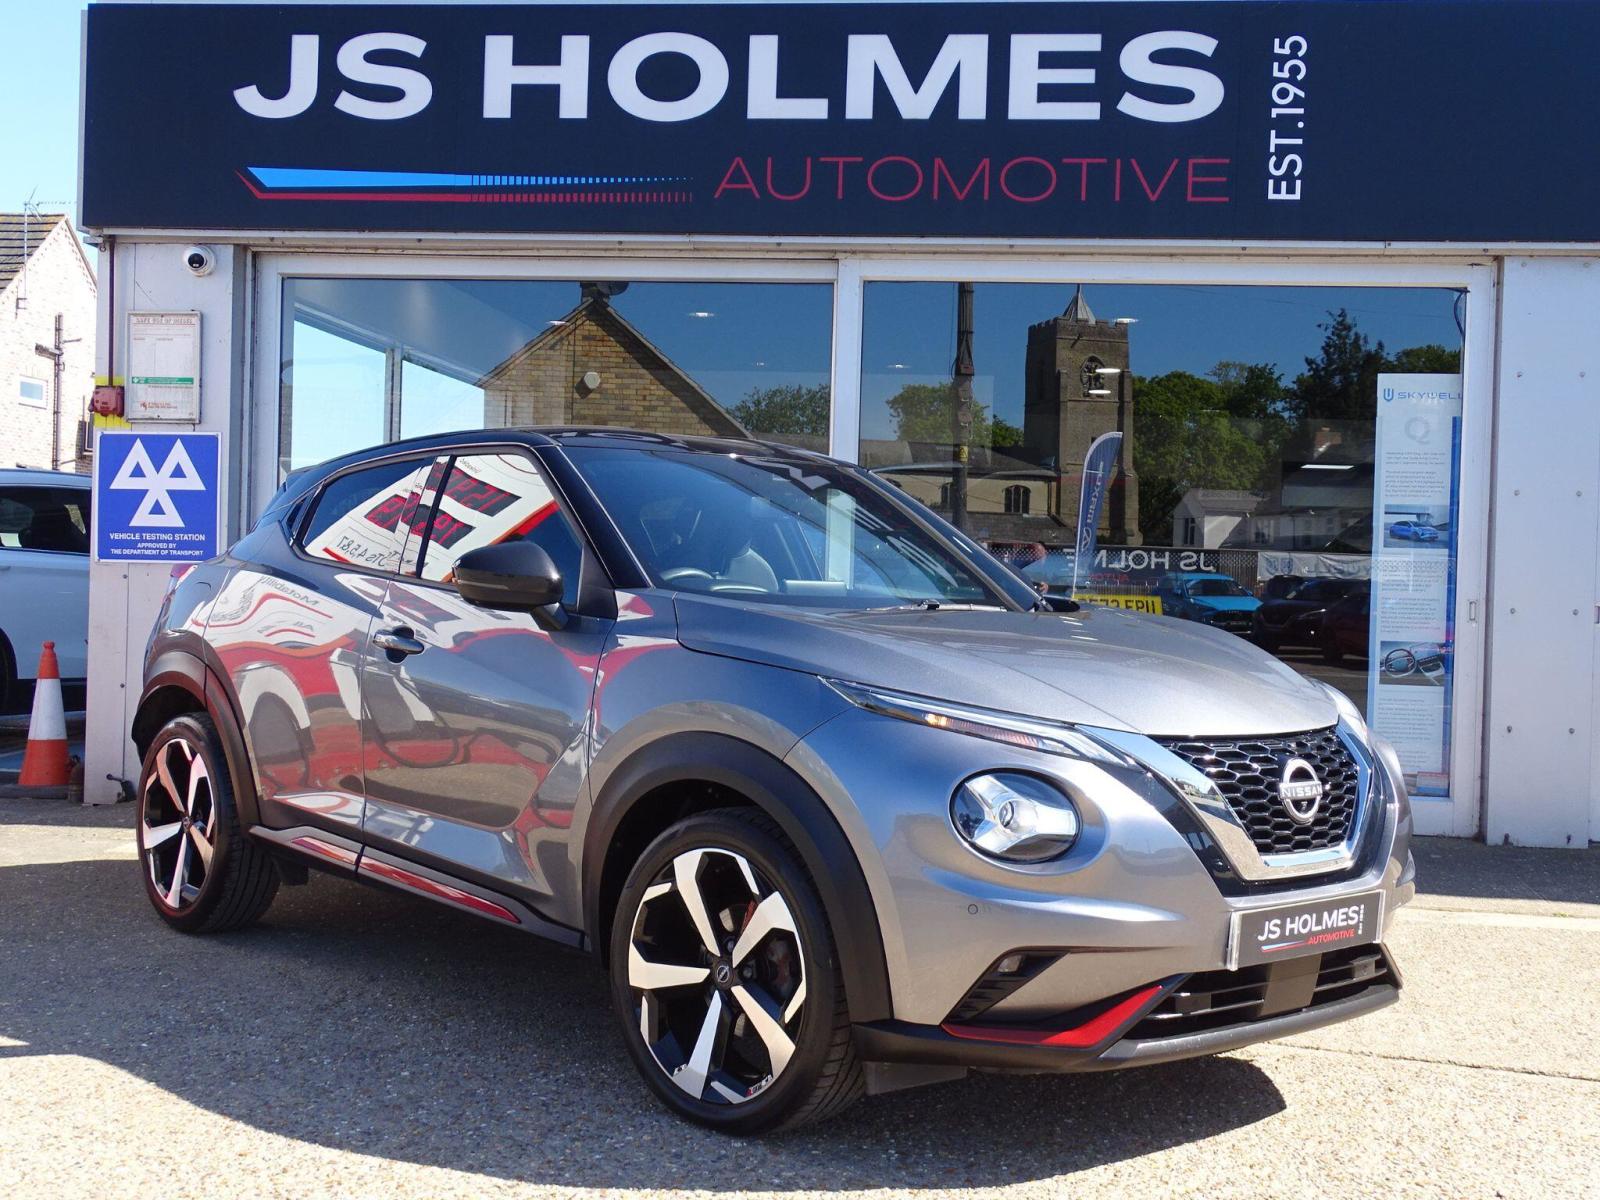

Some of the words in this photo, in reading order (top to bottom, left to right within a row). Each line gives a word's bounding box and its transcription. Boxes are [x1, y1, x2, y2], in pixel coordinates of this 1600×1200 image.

[233, 32, 433, 121] JS
[483, 31, 1226, 123] HOLMES
[1267, 35, 1308, 201] EST.1955
[713, 155, 1231, 204] AUTOMOTIVE
[109, 532, 140, 540] VEHICLE
[142, 533, 173, 541] TESTING
[174, 533, 206, 541] STATION
[1281, 784, 1321, 798] NISSAN
[1257, 919, 1281, 941] JS
[1285, 905, 1360, 936] HOLMES
[1307, 928, 1355, 945] AUTOMOTIVE
